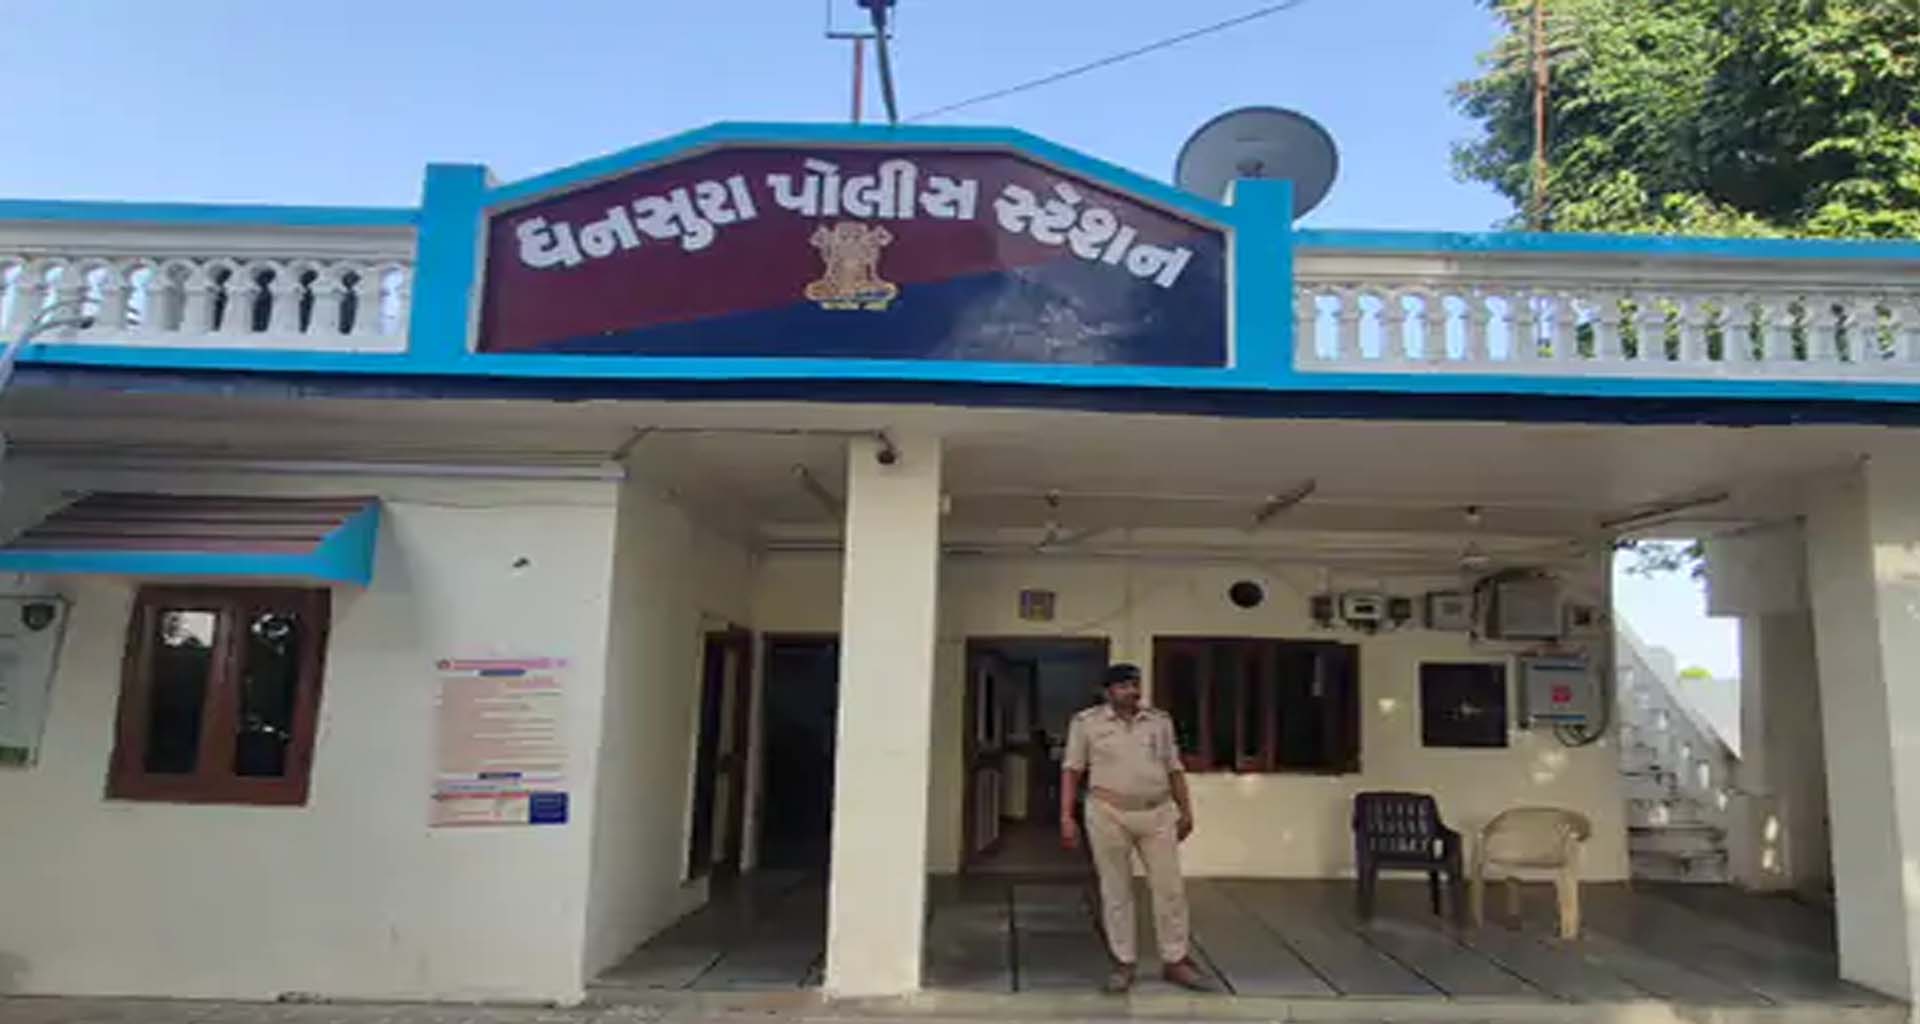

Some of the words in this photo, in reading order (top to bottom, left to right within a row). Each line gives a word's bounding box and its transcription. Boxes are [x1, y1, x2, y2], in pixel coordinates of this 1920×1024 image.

[516, 175, 758, 268] ધનસુરા
[766, 158, 978, 220] પોલીસ
[993, 181, 1194, 289] સ્ટેશન
